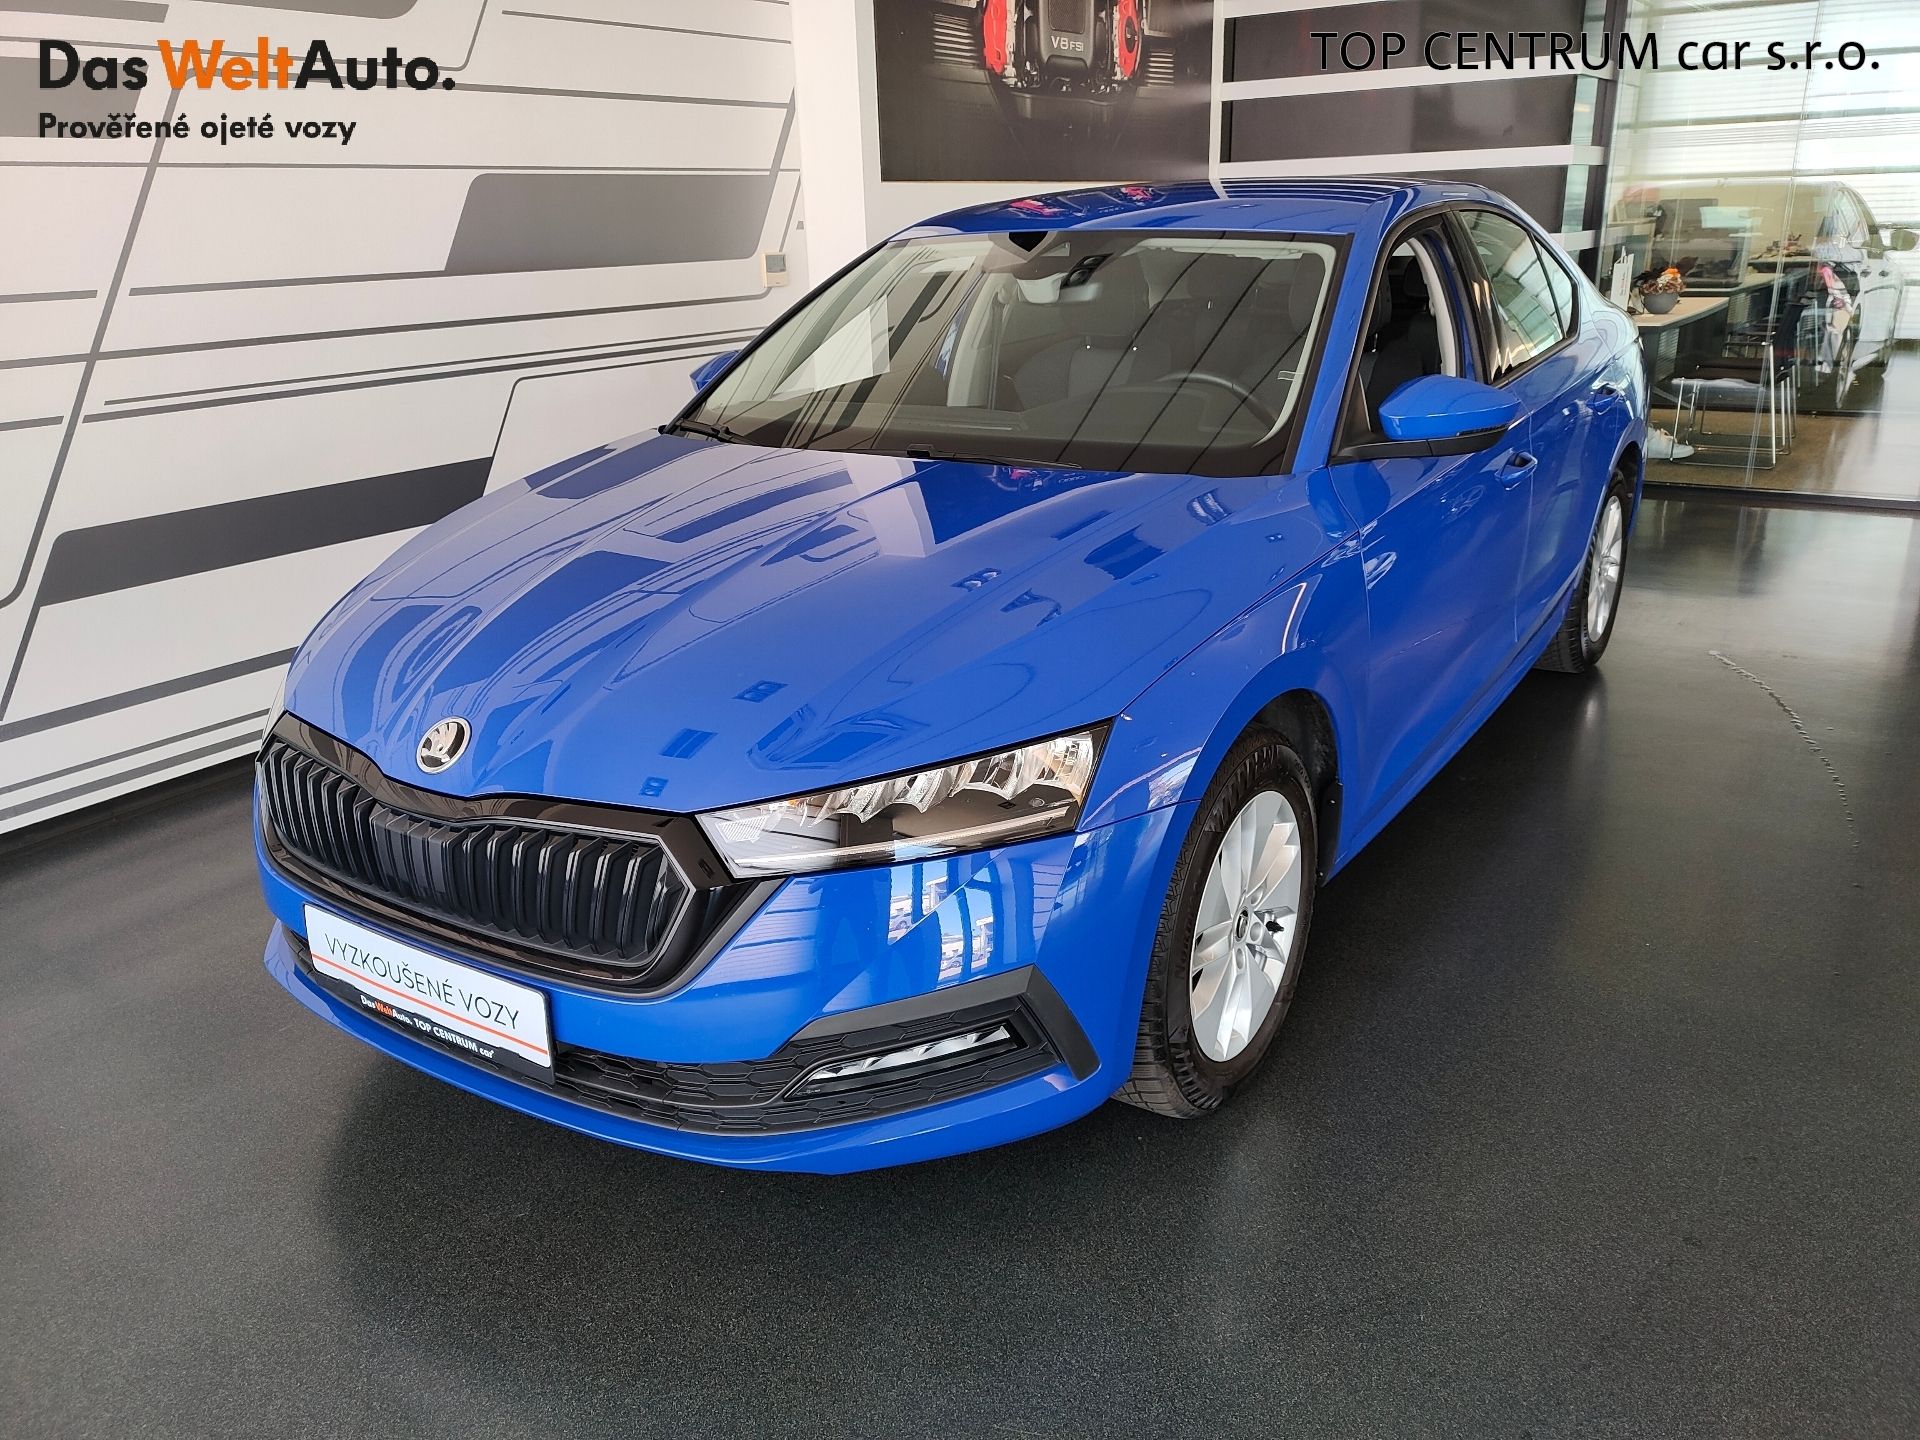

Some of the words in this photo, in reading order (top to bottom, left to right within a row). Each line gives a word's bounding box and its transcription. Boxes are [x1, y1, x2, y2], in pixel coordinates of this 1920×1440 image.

[324, 933, 456, 1006] VYZKOUŠENÉ
[458, 988, 519, 1030] VOZY
[413, 1018, 432, 1033] TOP
[432, 1026, 478, 1053] CENTRUM
